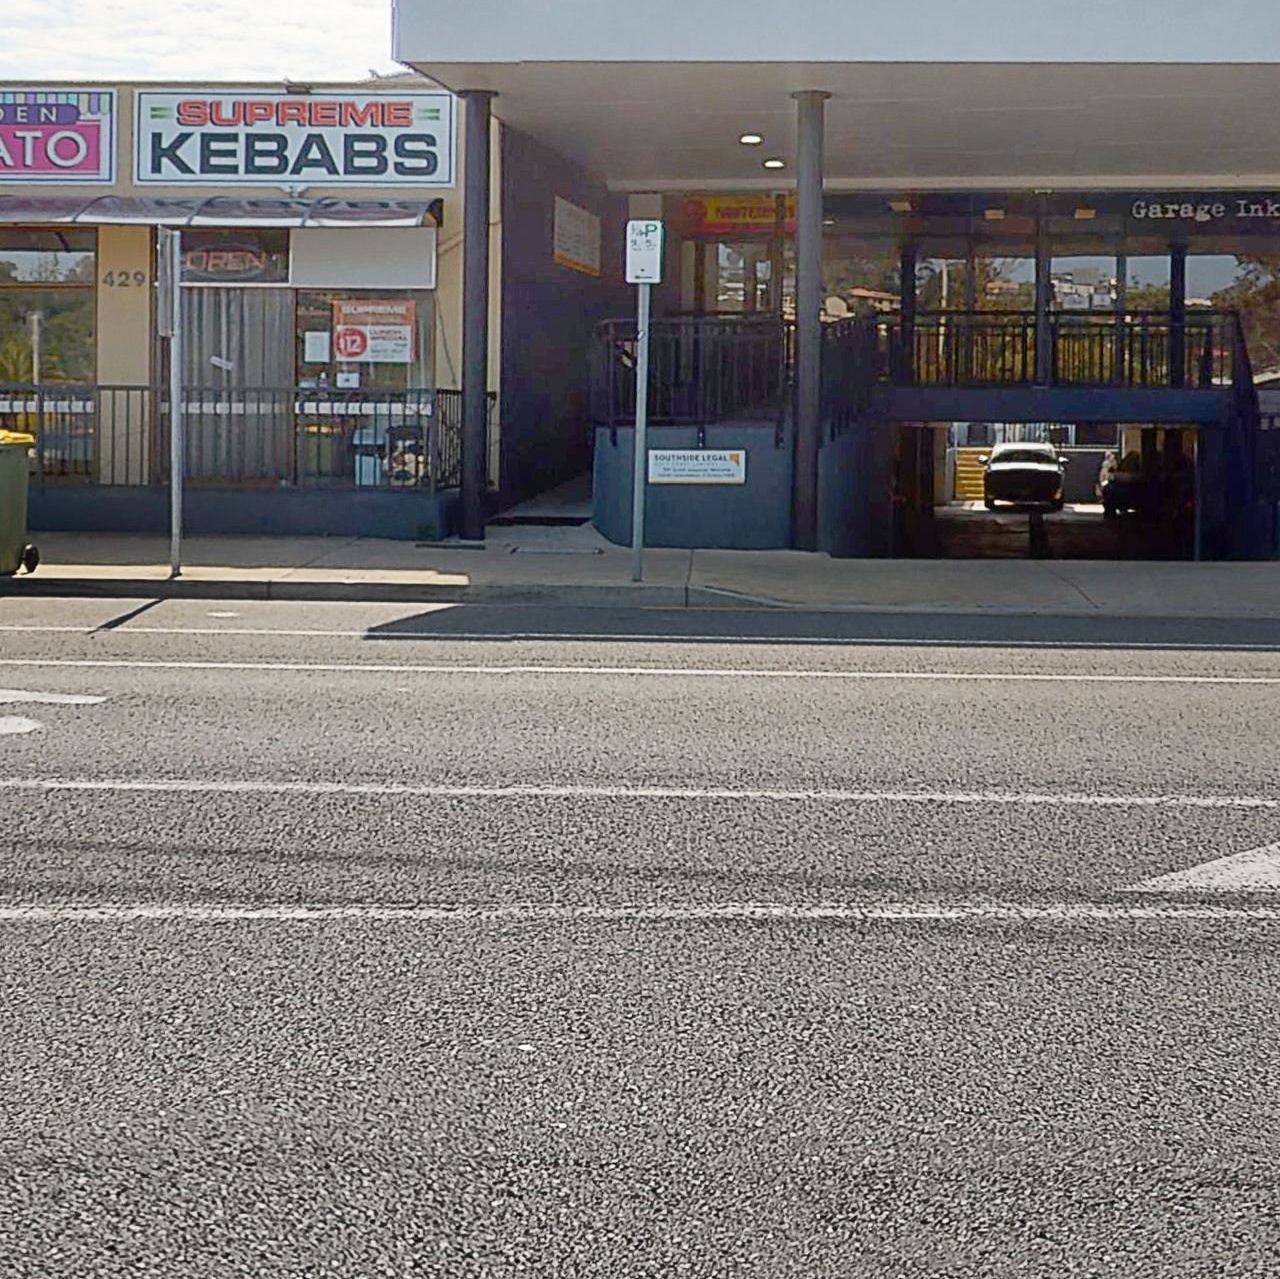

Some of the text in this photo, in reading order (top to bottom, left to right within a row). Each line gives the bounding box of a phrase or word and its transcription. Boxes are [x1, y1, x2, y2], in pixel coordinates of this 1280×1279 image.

[176, 99, 415, 128] SUPREME
[150, 131, 439, 177] KEBABS
[1131, 199, 1226, 222] Garage
[102, 271, 146, 287] 429
